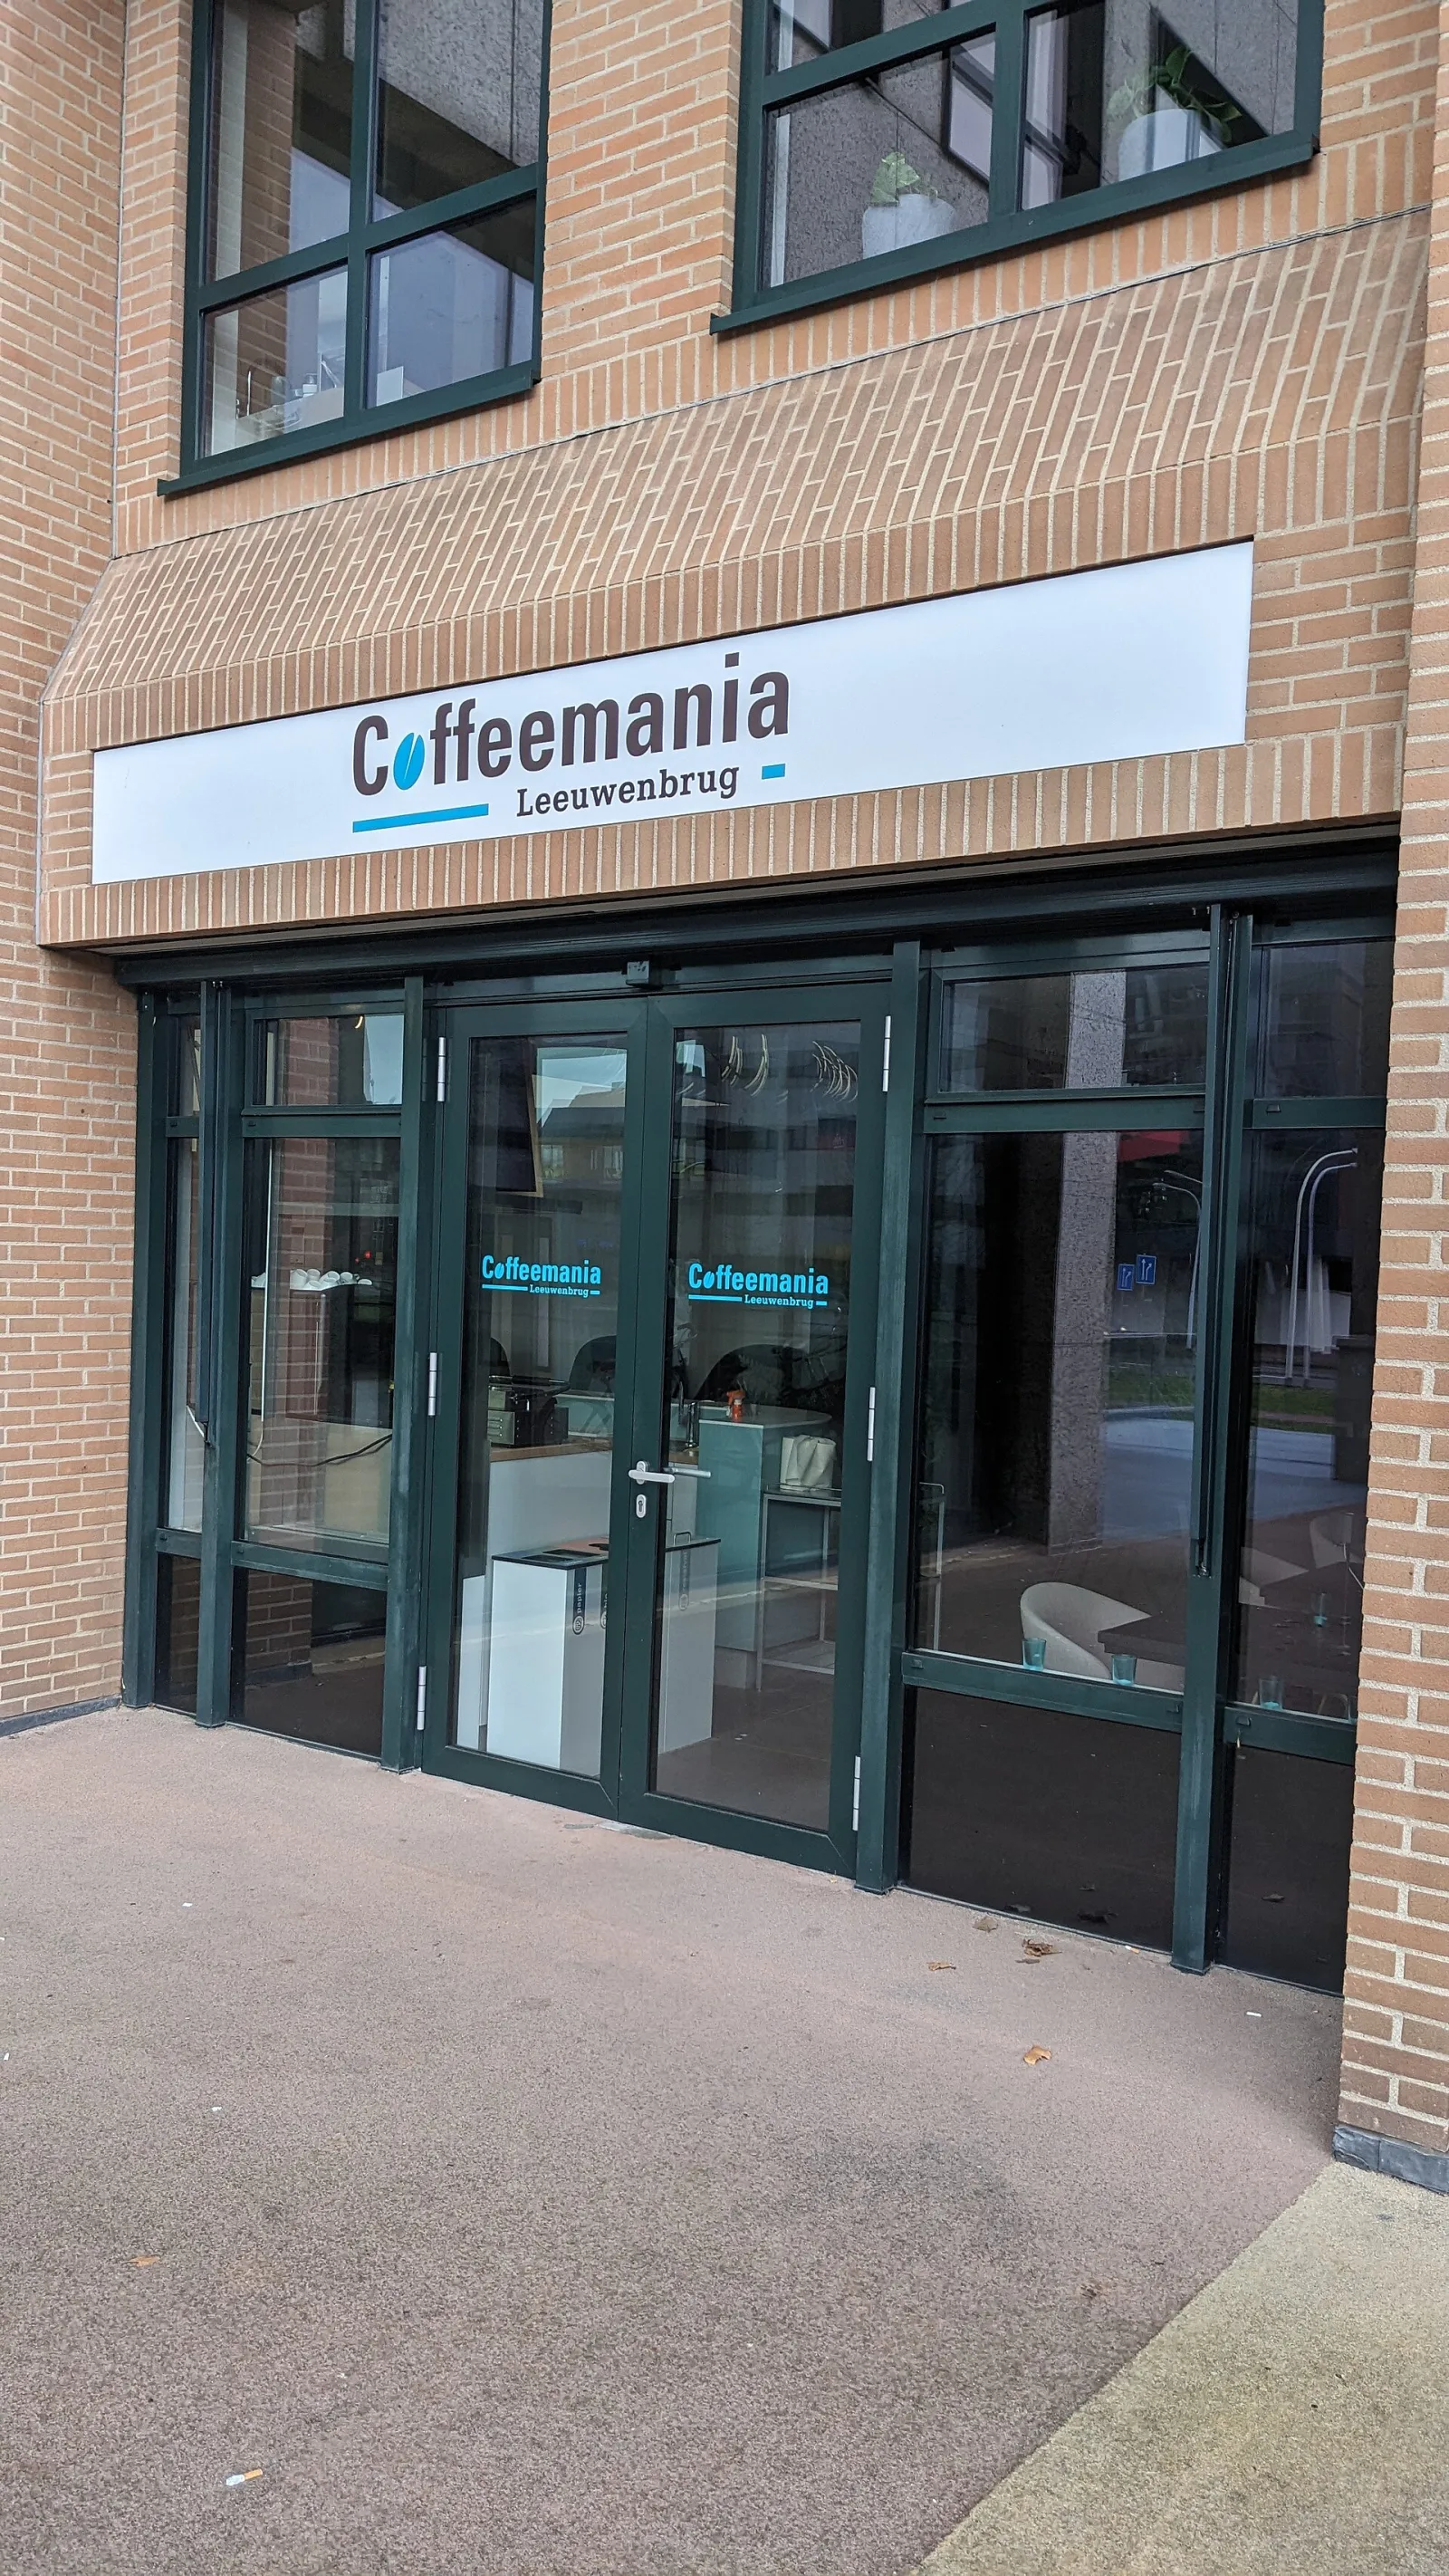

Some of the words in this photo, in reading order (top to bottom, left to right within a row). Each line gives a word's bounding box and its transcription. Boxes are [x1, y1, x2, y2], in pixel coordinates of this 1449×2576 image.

[352, 651, 790, 796] Coffeemania
[516, 765, 740, 818] Leeuwenbrug
[482, 1254, 601, 1284] Coffeemania
[688, 1263, 829, 1294] Coffeemania
[529, 1283, 590, 1298] Leeuwenbrug
[744, 1294, 814, 1310] Leeuwenbrug
